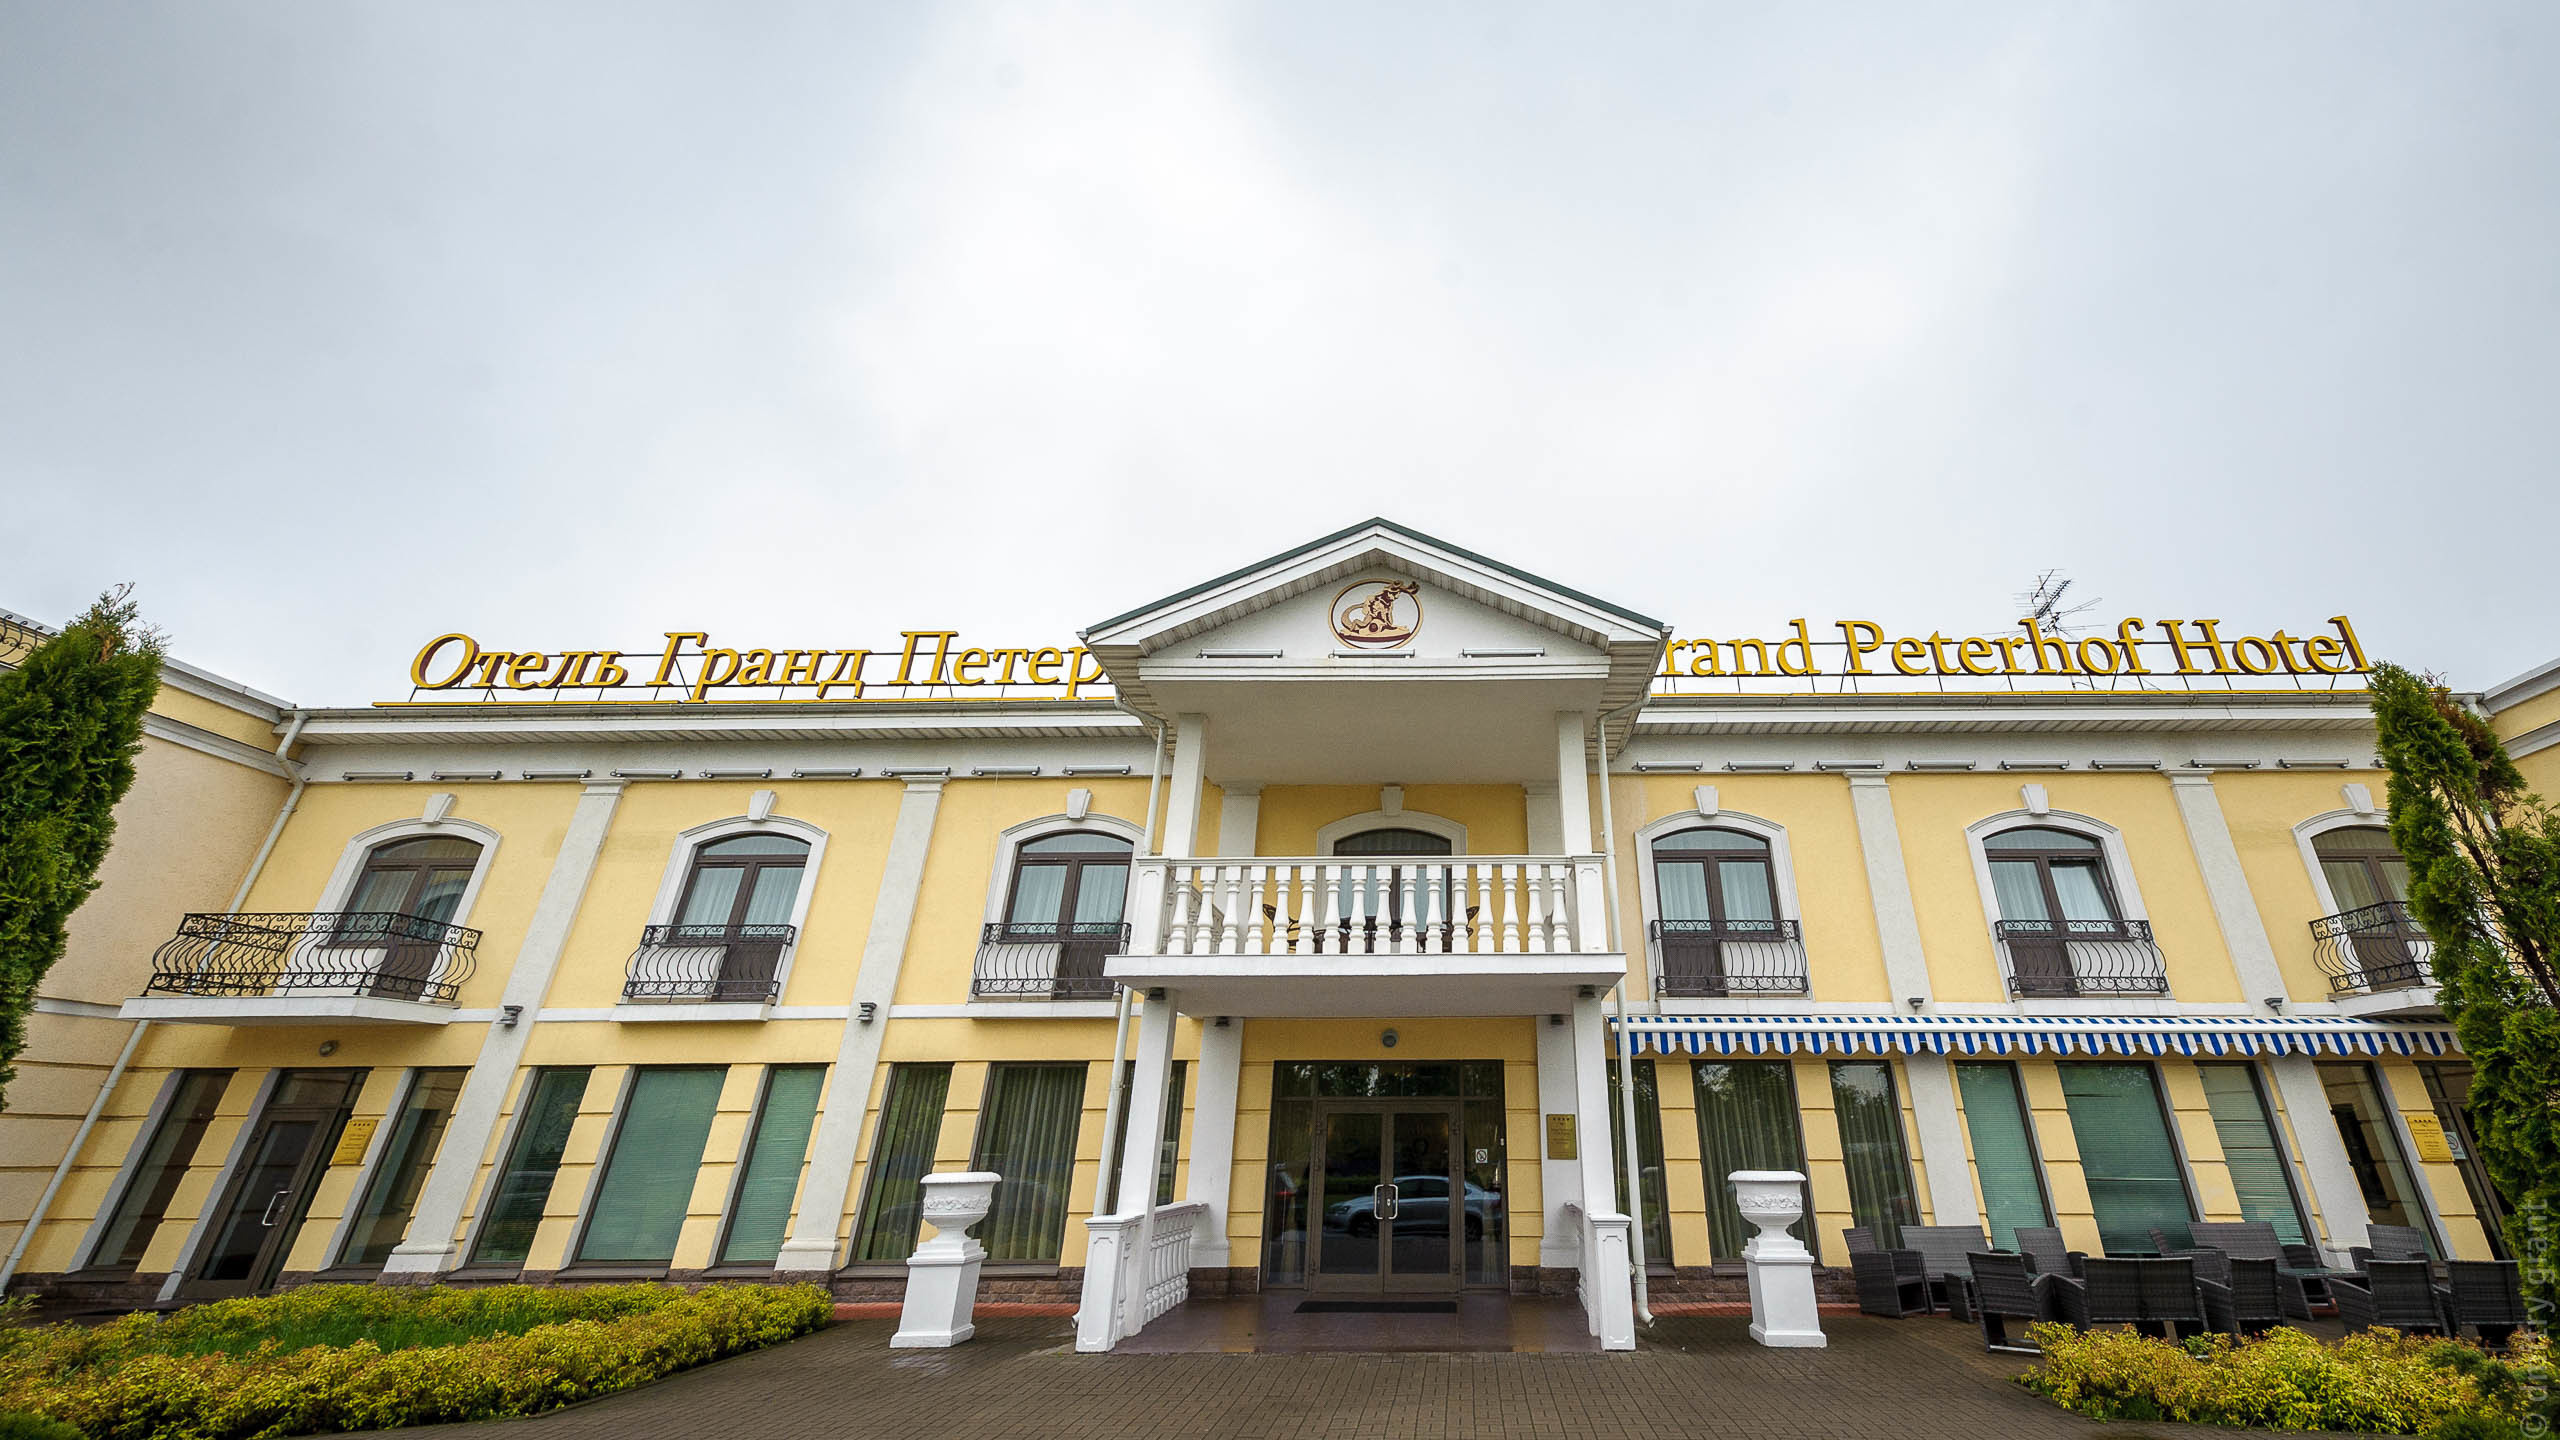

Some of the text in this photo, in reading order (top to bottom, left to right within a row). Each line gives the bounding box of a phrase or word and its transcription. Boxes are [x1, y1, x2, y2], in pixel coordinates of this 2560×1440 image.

[409, 631, 1104, 703] Отель Гранд Петер
[1661, 615, 2373, 677] rand Peterhof Hotel
